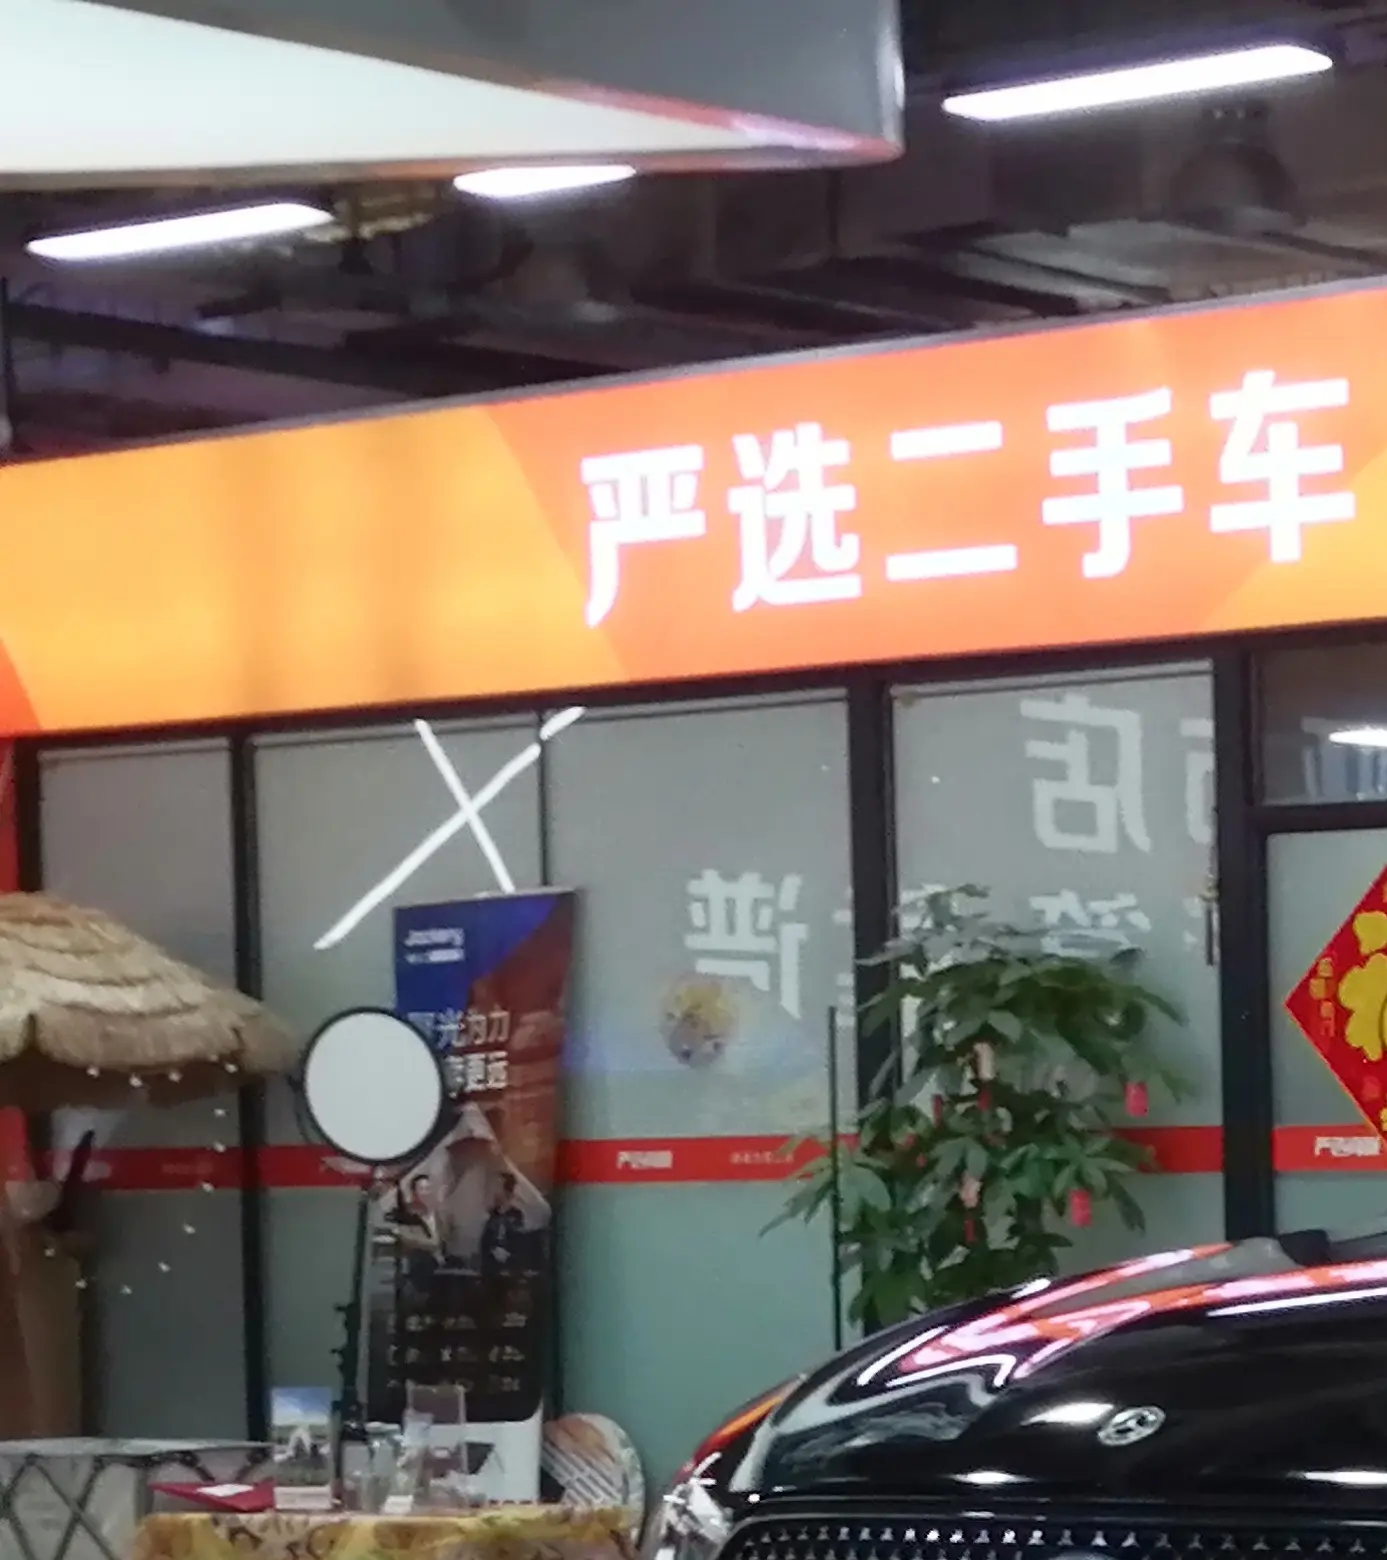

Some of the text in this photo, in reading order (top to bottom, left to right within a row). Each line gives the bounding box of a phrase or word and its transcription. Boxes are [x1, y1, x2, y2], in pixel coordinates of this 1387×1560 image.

[580, 369, 1357, 628] 严选二手车
